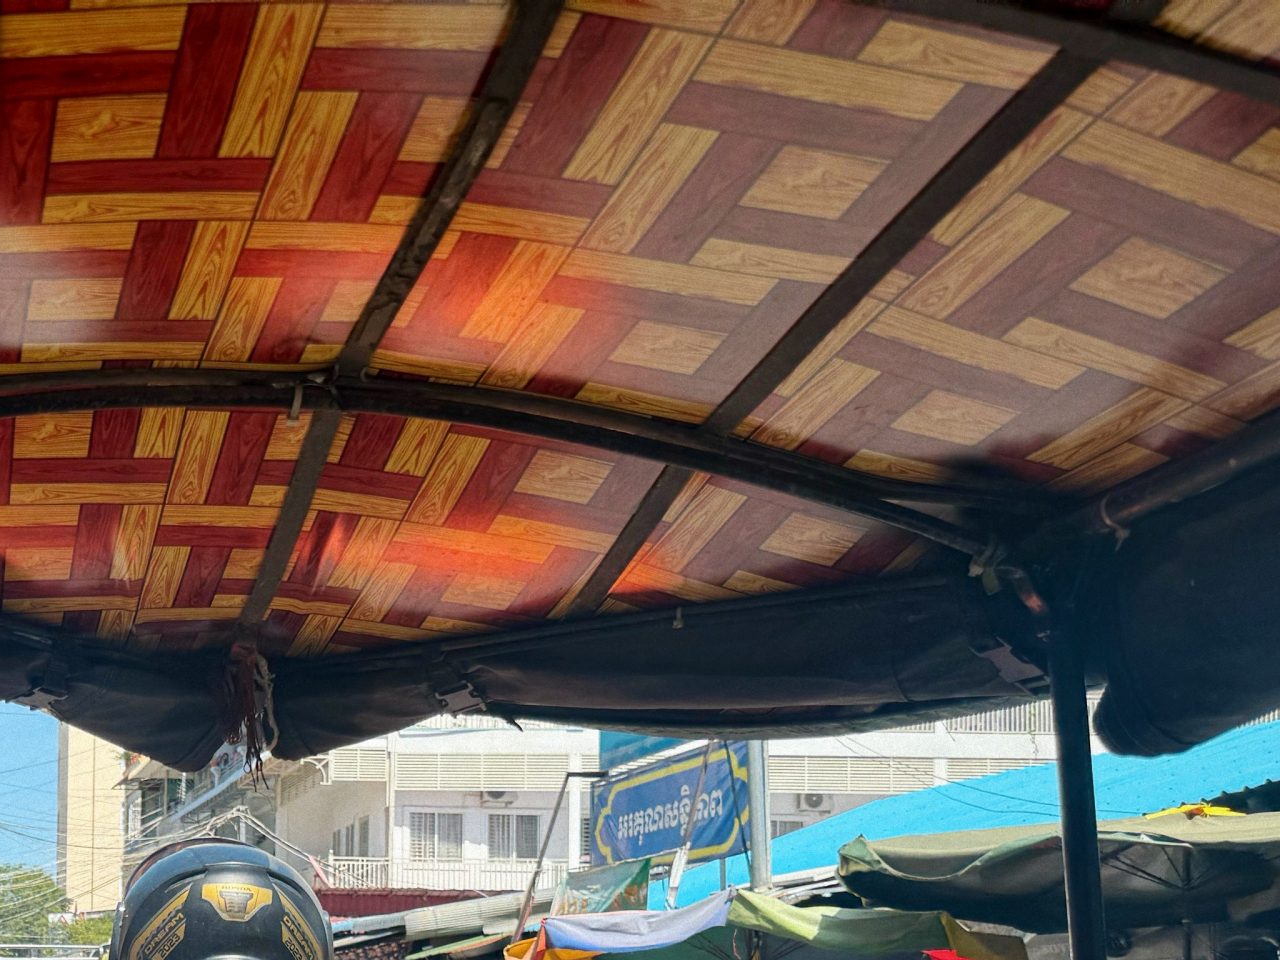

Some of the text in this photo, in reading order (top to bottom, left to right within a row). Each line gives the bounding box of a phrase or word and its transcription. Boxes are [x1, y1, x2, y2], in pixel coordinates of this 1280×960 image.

[144, 913, 184, 955] DREAM
[159, 931, 181, 958] 2023
[282, 915, 313, 960] DREAM
